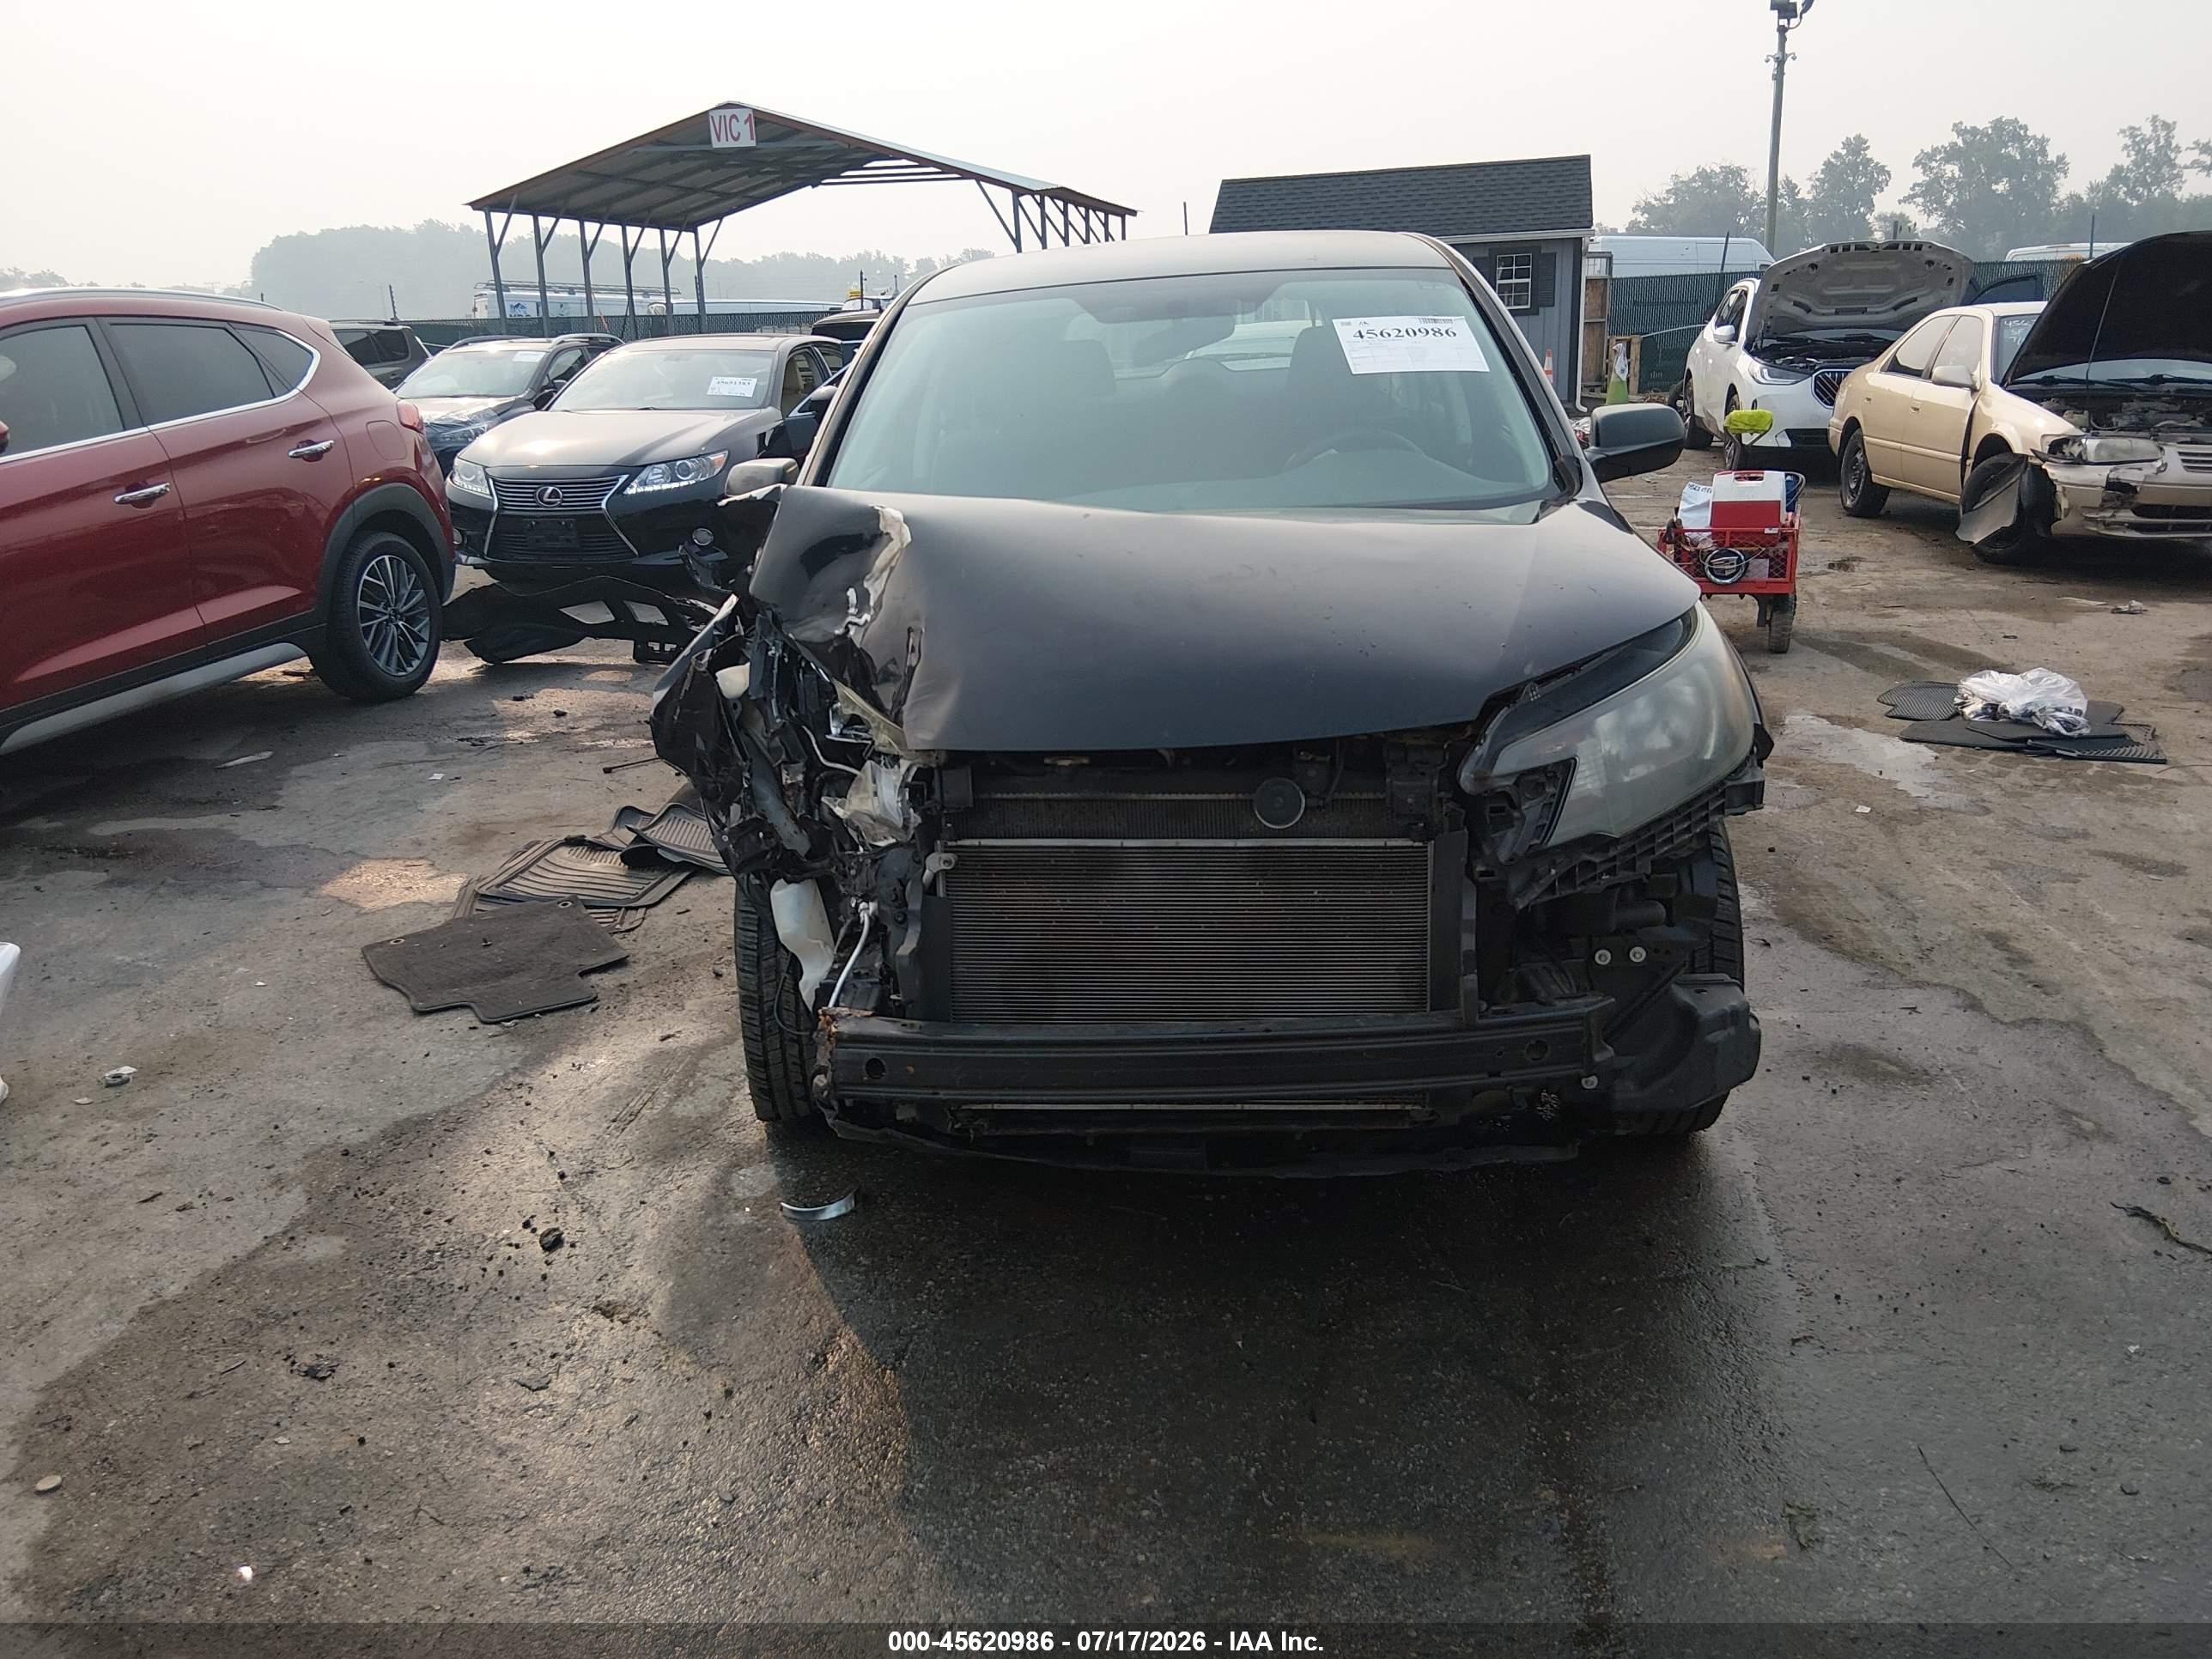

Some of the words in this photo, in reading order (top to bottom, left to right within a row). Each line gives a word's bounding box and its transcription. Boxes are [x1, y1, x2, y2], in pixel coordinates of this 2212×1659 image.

[710, 114, 741, 143] VIC
[744, 113, 755, 141] 1
[1352, 326, 1457, 340] 45620986
